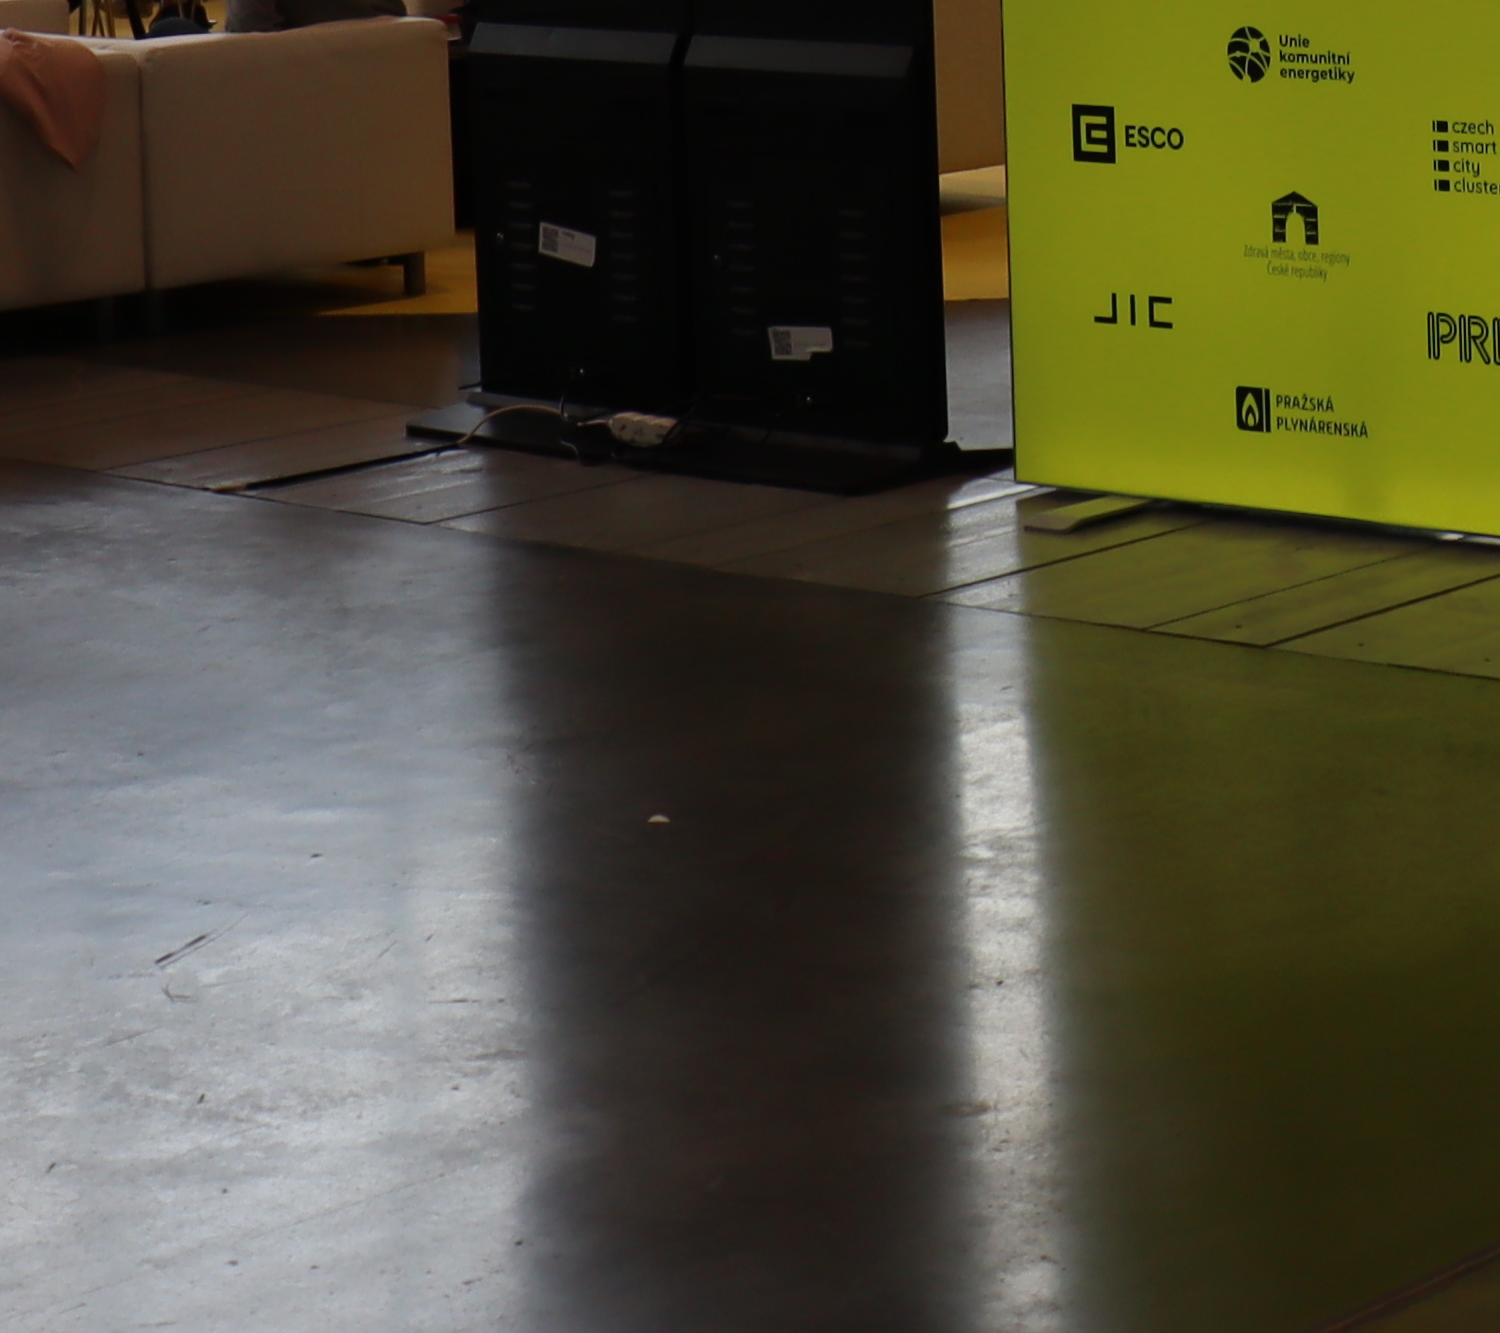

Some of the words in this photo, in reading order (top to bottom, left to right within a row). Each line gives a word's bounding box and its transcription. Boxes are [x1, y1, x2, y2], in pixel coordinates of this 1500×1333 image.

[1279, 34, 1309, 48] Unie
[1279, 49, 1349, 65] komunitní
[1279, 66, 1354, 84] energetiky
[1125, 125, 1184, 150] ESCO
[1276, 393, 1334, 412] PRAŽSKÁ
[1276, 416, 1368, 438] PLYNÁRENSKÁ
